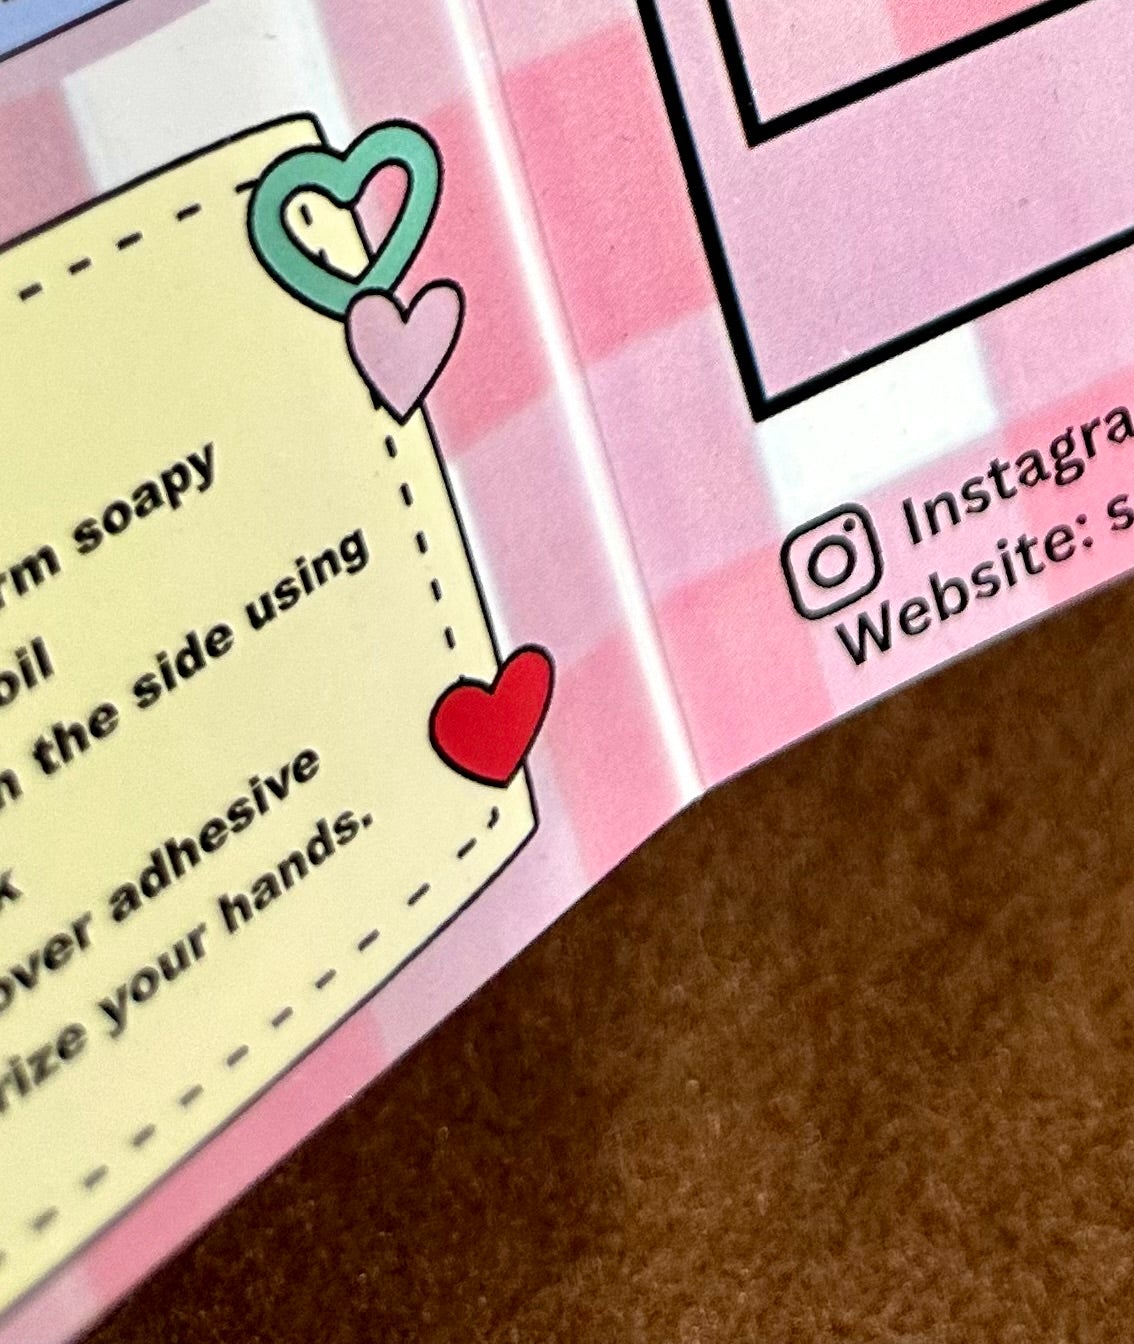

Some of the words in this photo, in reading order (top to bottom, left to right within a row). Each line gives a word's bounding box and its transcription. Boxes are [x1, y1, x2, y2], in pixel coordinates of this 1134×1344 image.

[0, 544, 61, 608] m
[72, 441, 216, 556] soapy
[834, 515, 1095, 667] Website:
[0, 636, 55, 708] oil
[31, 701, 119, 776] the
[131, 622, 235, 710] side
[244, 528, 370, 632] using
[107, 748, 321, 924] adhesive
[97, 922, 207, 1039] your
[216, 813, 374, 935] hands.
